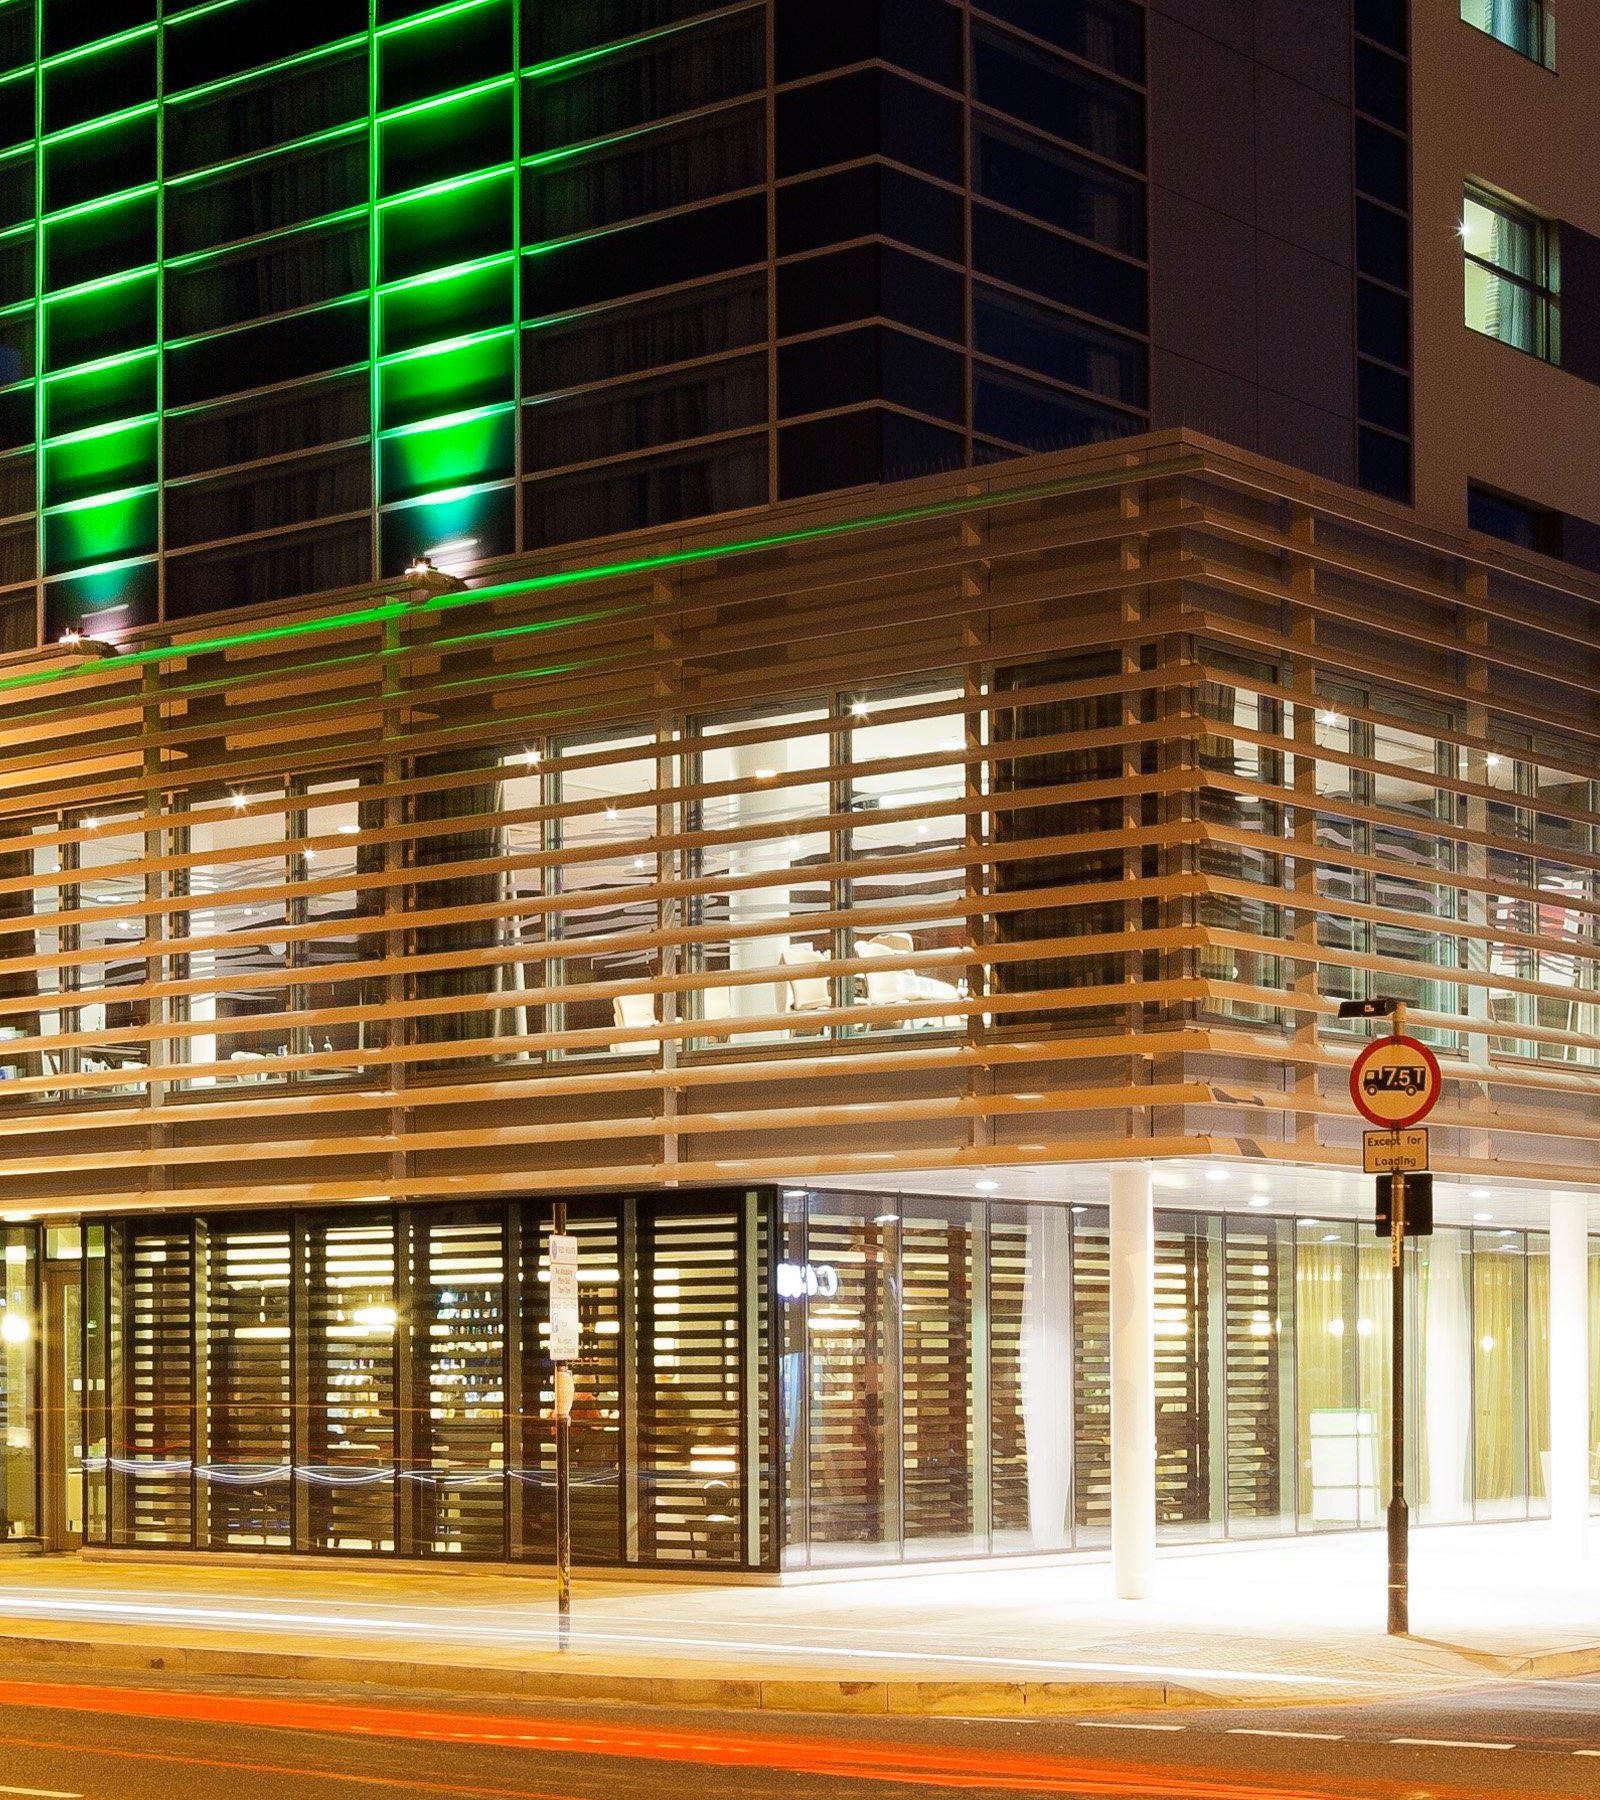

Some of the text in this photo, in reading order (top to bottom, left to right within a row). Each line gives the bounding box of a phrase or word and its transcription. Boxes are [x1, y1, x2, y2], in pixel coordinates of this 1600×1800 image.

[1367, 1135, 1422, 1148] Except for
[1374, 1155, 1417, 1168] Loading
